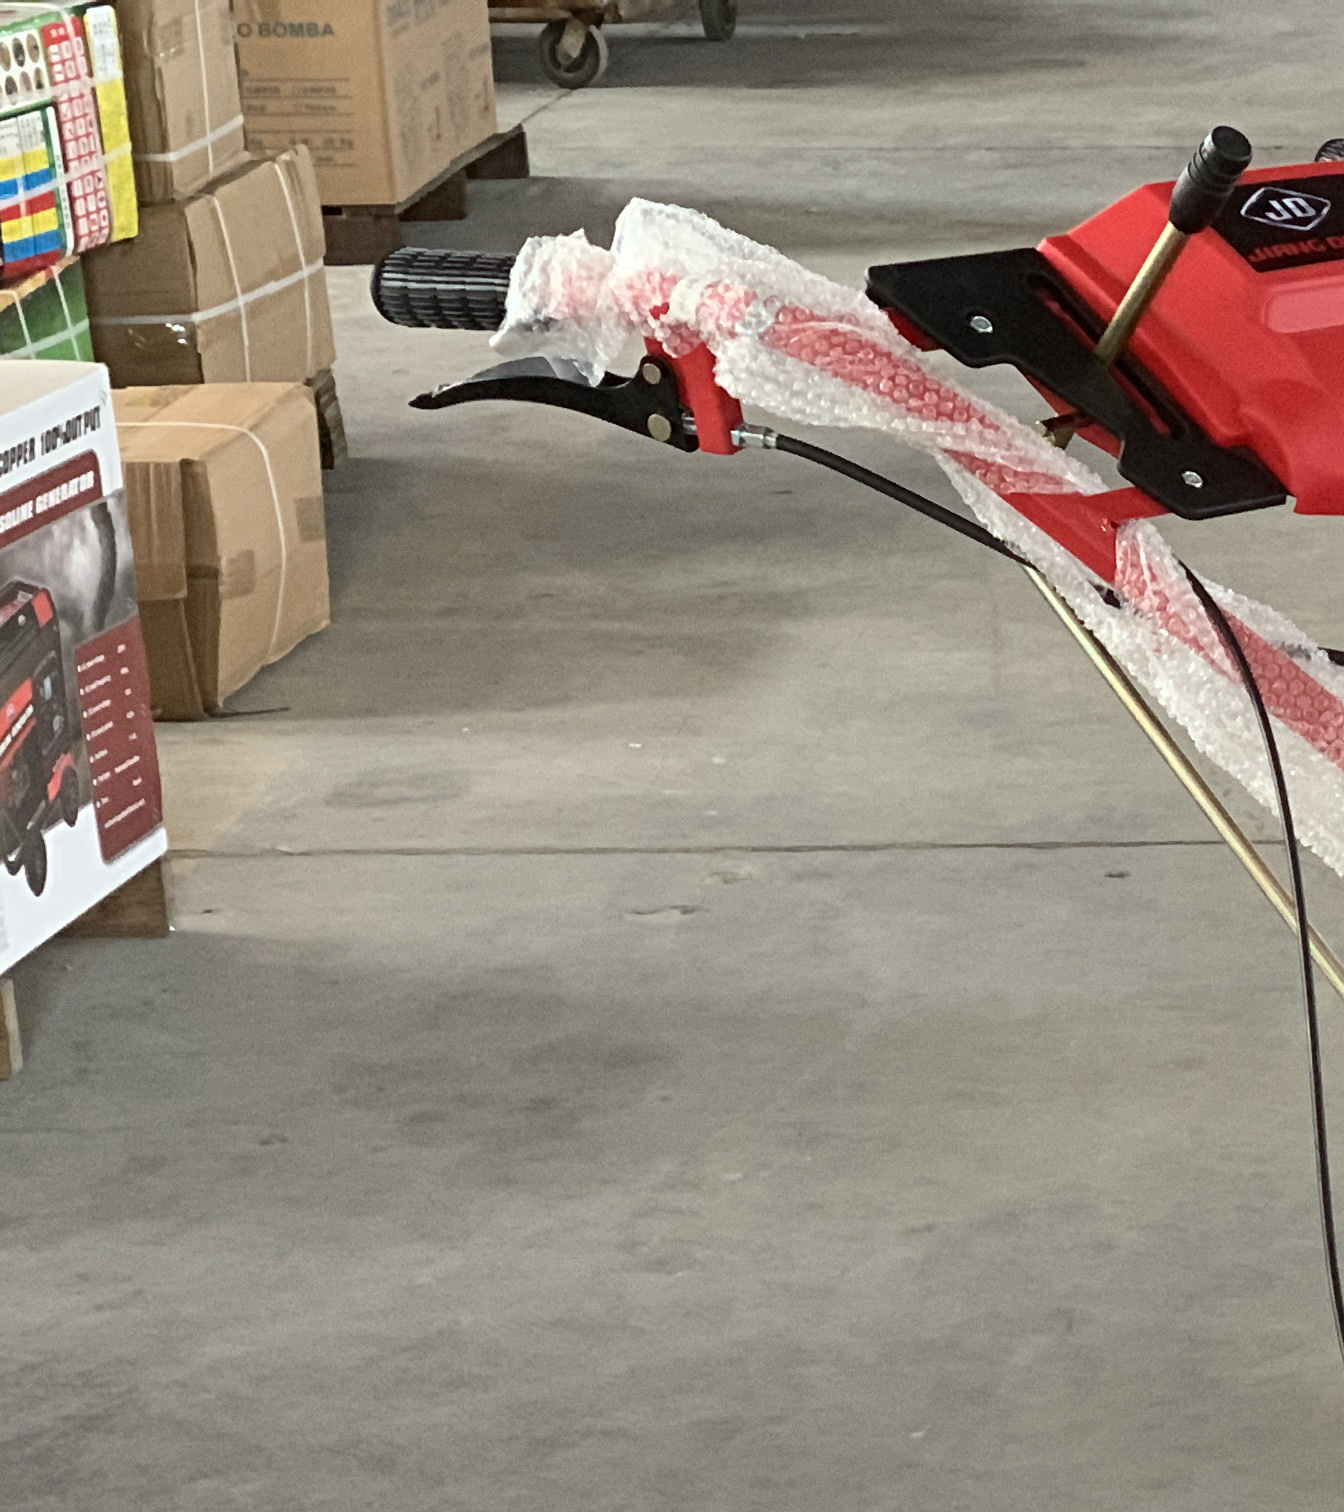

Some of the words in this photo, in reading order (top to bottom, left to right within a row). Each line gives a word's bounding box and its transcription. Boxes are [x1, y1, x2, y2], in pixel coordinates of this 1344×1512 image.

[258, 22, 335, 38] BOMBA
[1250, 239, 1327, 262] JIANG
[36, 470, 95, 515] GENERATOR
